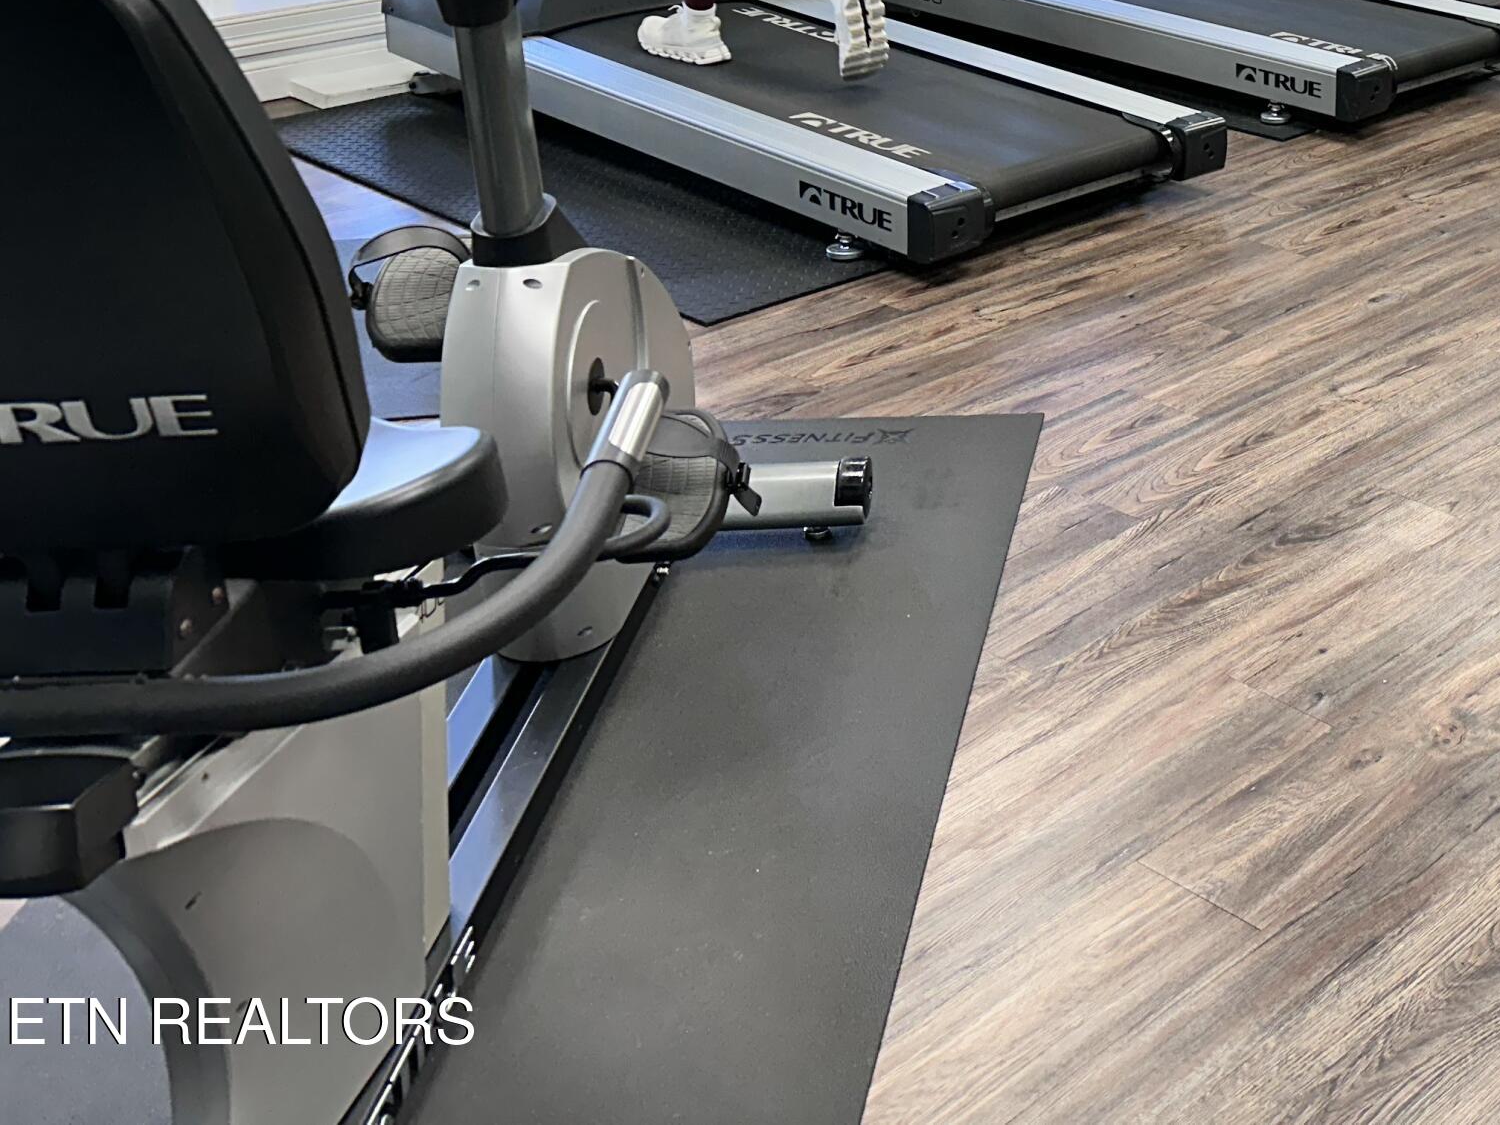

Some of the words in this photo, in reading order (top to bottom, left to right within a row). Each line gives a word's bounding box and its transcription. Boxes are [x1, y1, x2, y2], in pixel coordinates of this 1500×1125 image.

[731, 6, 818, 36] TRUE
[1258, 68, 1322, 99] TRUE
[828, 122, 933, 159] TRUE
[822, 190, 893, 233] TRUE
[0, 394, 219, 445] RUE
